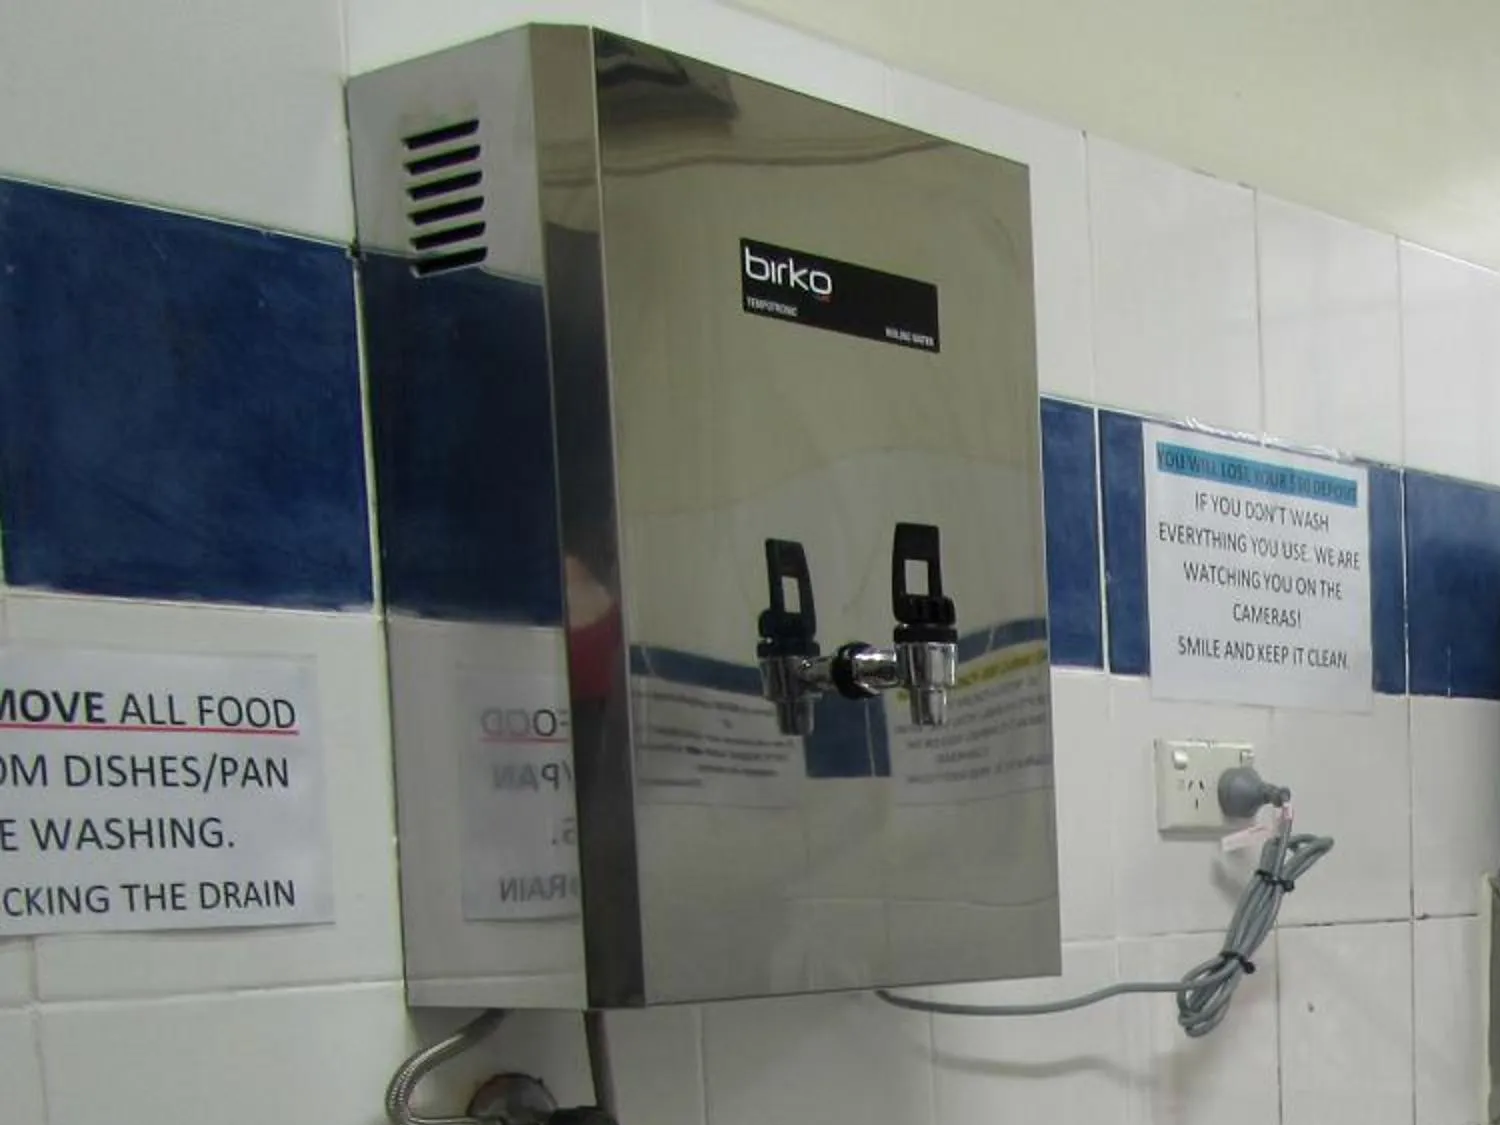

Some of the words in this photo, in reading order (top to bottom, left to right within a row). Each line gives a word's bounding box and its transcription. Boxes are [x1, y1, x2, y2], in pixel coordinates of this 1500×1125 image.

[744, 246, 832, 295] birko
[1194, 491, 1208, 512] IF
[1210, 495, 1241, 517] YOU
[1245, 500, 1286, 525] DON'T
[1289, 507, 1329, 533] WASH
[1159, 520, 1247, 553] EVERYTHING
[1250, 535, 1279, 558] YOU
[1314, 544, 1336, 567] WE
[1337, 549, 1360, 570] ARE
[1183, 560, 1260, 589] WATCHING
[1263, 570, 1293, 593] YOU
[1295, 577, 1317, 597] ON
[1319, 579, 1343, 600] THE
[1232, 603, 1301, 629] CAMERAS!
[1178, 635, 1220, 659] SMILE
[1223, 640, 1255, 661] AND
[1257, 643, 1289, 665] KEEP
[1293, 646, 1305, 665] IT
[120, 692, 186, 725] ALL
[198, 695, 296, 728] FOOD
[64, 753, 289, 793] DISHES/PAN
[0, 819, 18, 851] E
[30, 817, 234, 851] WASHING.
[4, 884, 110, 917] CKING
[119, 883, 187, 912] THE
[199, 880, 295, 910] DRAIN
